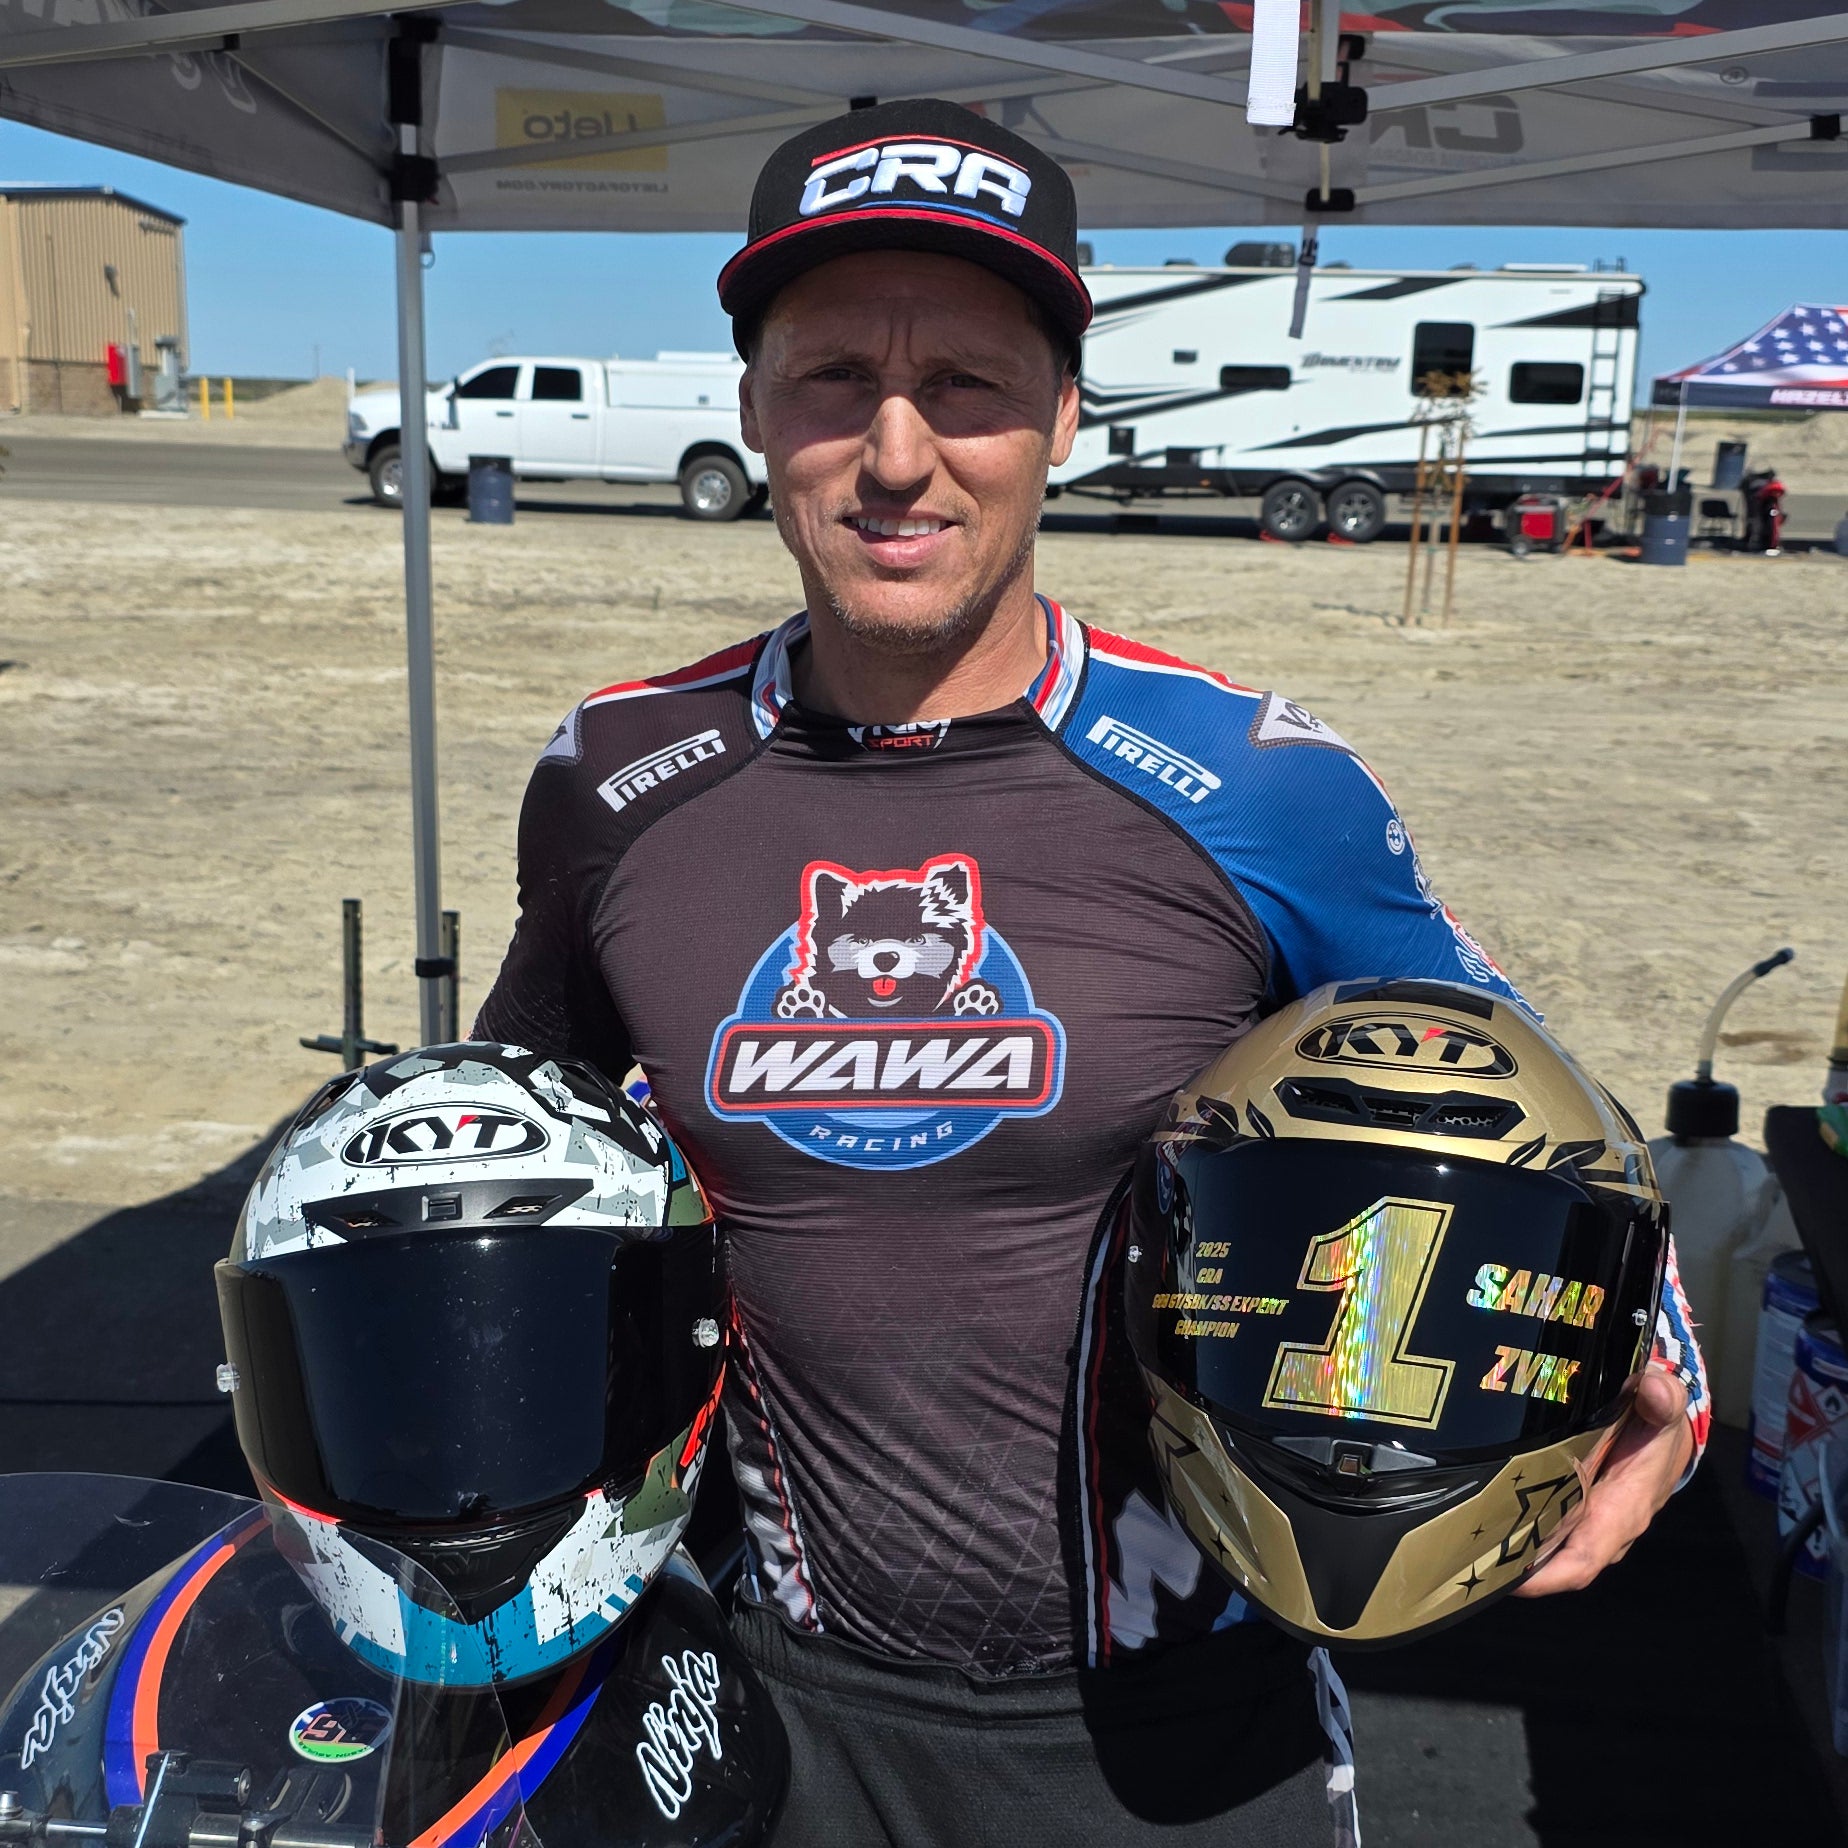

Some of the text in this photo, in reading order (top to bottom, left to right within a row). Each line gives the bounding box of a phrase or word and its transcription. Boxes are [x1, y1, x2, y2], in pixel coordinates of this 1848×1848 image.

[799, 143, 1032, 217] CRA
[597, 728, 727, 813] PIRELLI
[867, 735, 934, 749] SPORT
[1086, 714, 1222, 804] PIRELLI
[728, 1036, 1034, 1093] WAWA
[1321, 1022, 1496, 1065] KYT
[364, 1114, 526, 1164] KYT
[809, 1121, 953, 1152] RACING
[1195, 1241, 1232, 1259] 2025
[1196, 1267, 1224, 1284] CRA
[1230, 1295, 1290, 1316] EXPERT
[1262, 1196, 1456, 1431] 1
[1466, 1263, 1606, 1330] SAHAR
[1174, 1319, 1240, 1339] CHAMPION
[1479, 1344, 1582, 1404] ZVIK
[21, 1606, 126, 1770] Ninja
[636, 1649, 723, 1821] Ninja
